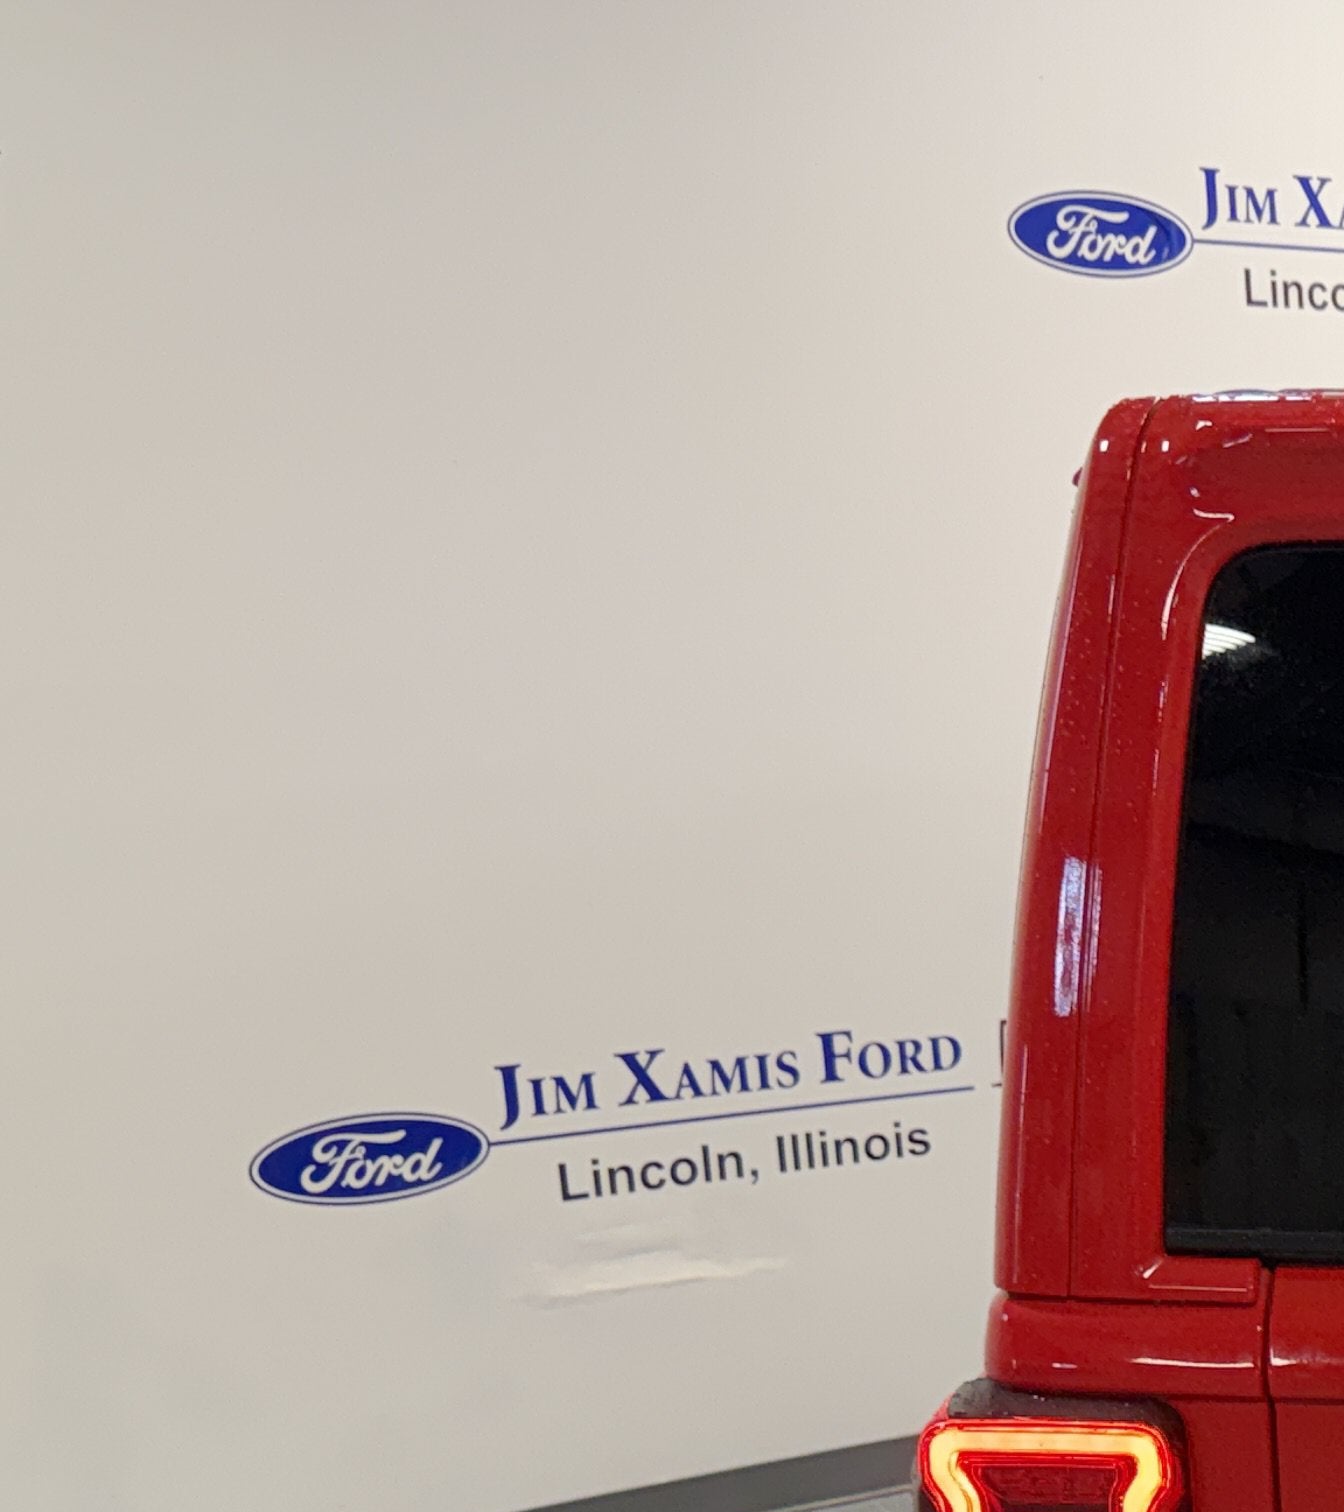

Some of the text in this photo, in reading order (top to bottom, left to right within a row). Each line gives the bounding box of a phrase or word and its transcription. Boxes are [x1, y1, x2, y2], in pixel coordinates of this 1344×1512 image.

[1046, 204, 1156, 264] Ford
[300, 1129, 443, 1194] Ford
[558, 1121, 932, 1202] Lincoln, Illinois
